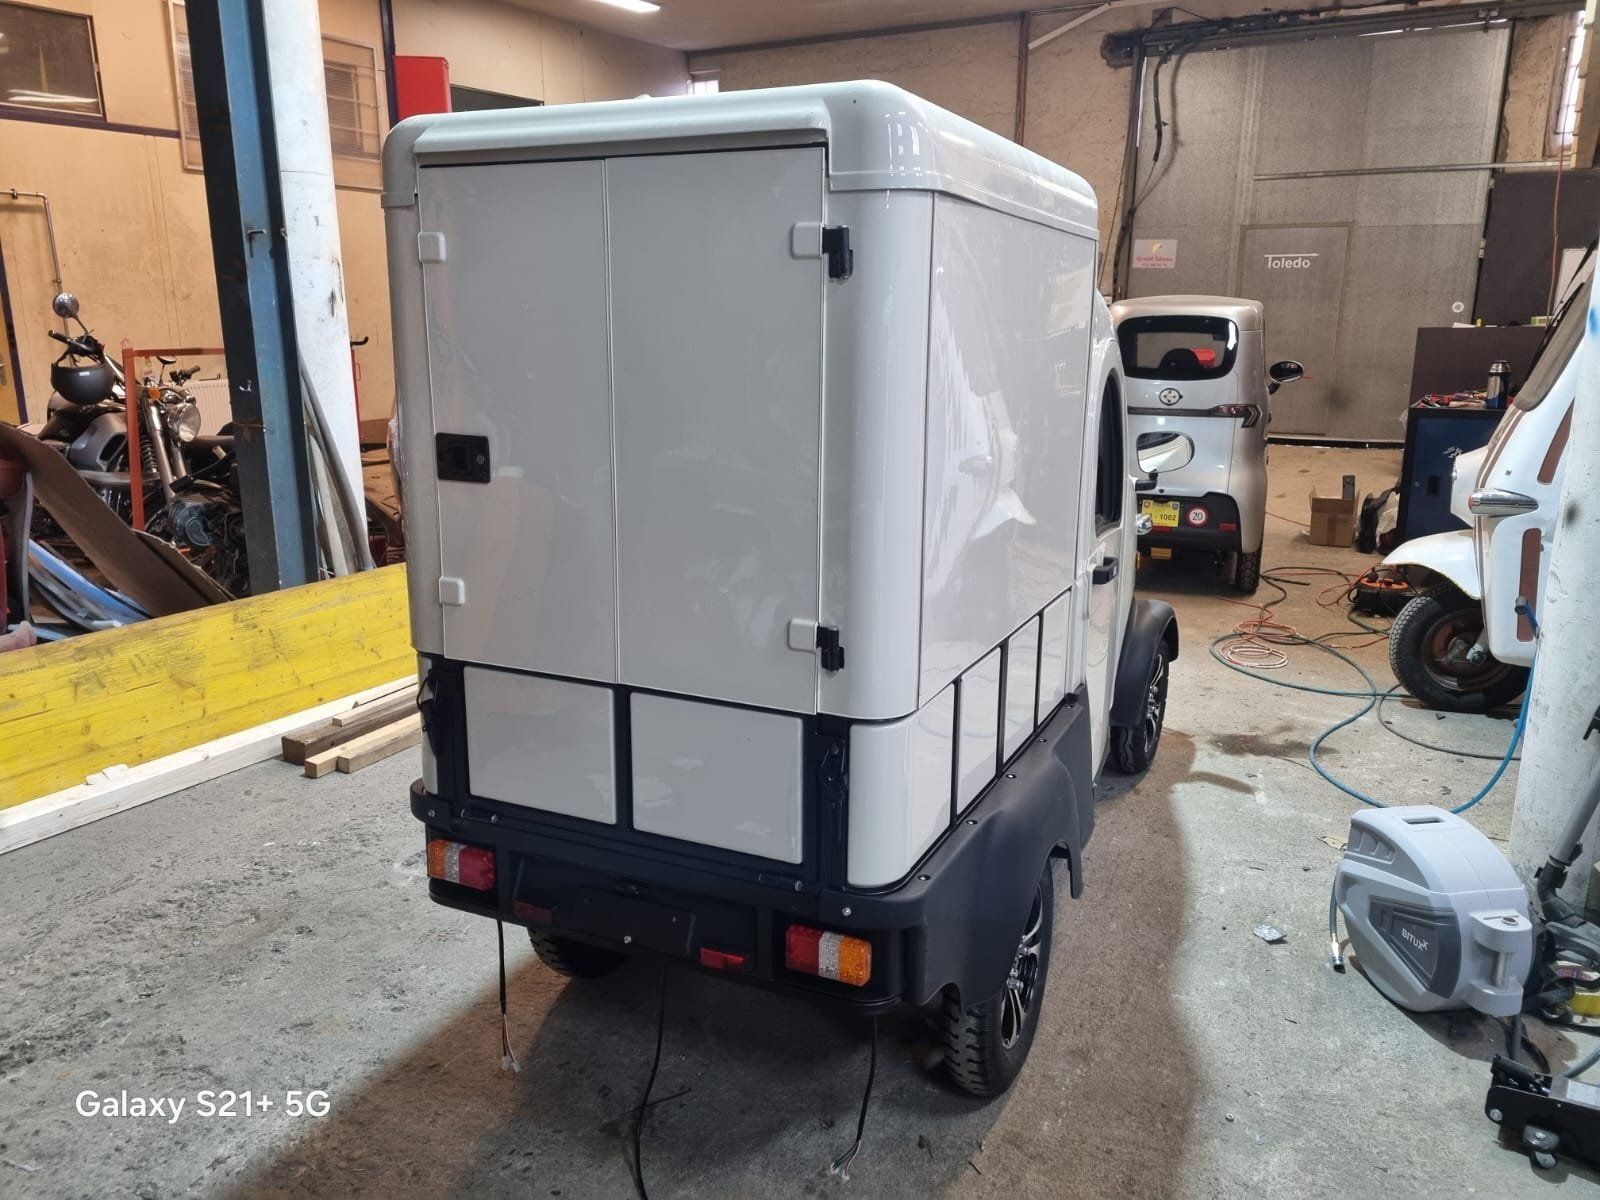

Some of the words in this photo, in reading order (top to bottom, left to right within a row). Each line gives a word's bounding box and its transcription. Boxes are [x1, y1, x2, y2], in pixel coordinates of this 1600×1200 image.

[1264, 252, 1317, 269] Toledo
[1159, 513, 1177, 522] 1002
[1192, 511, 1204, 521] 20
